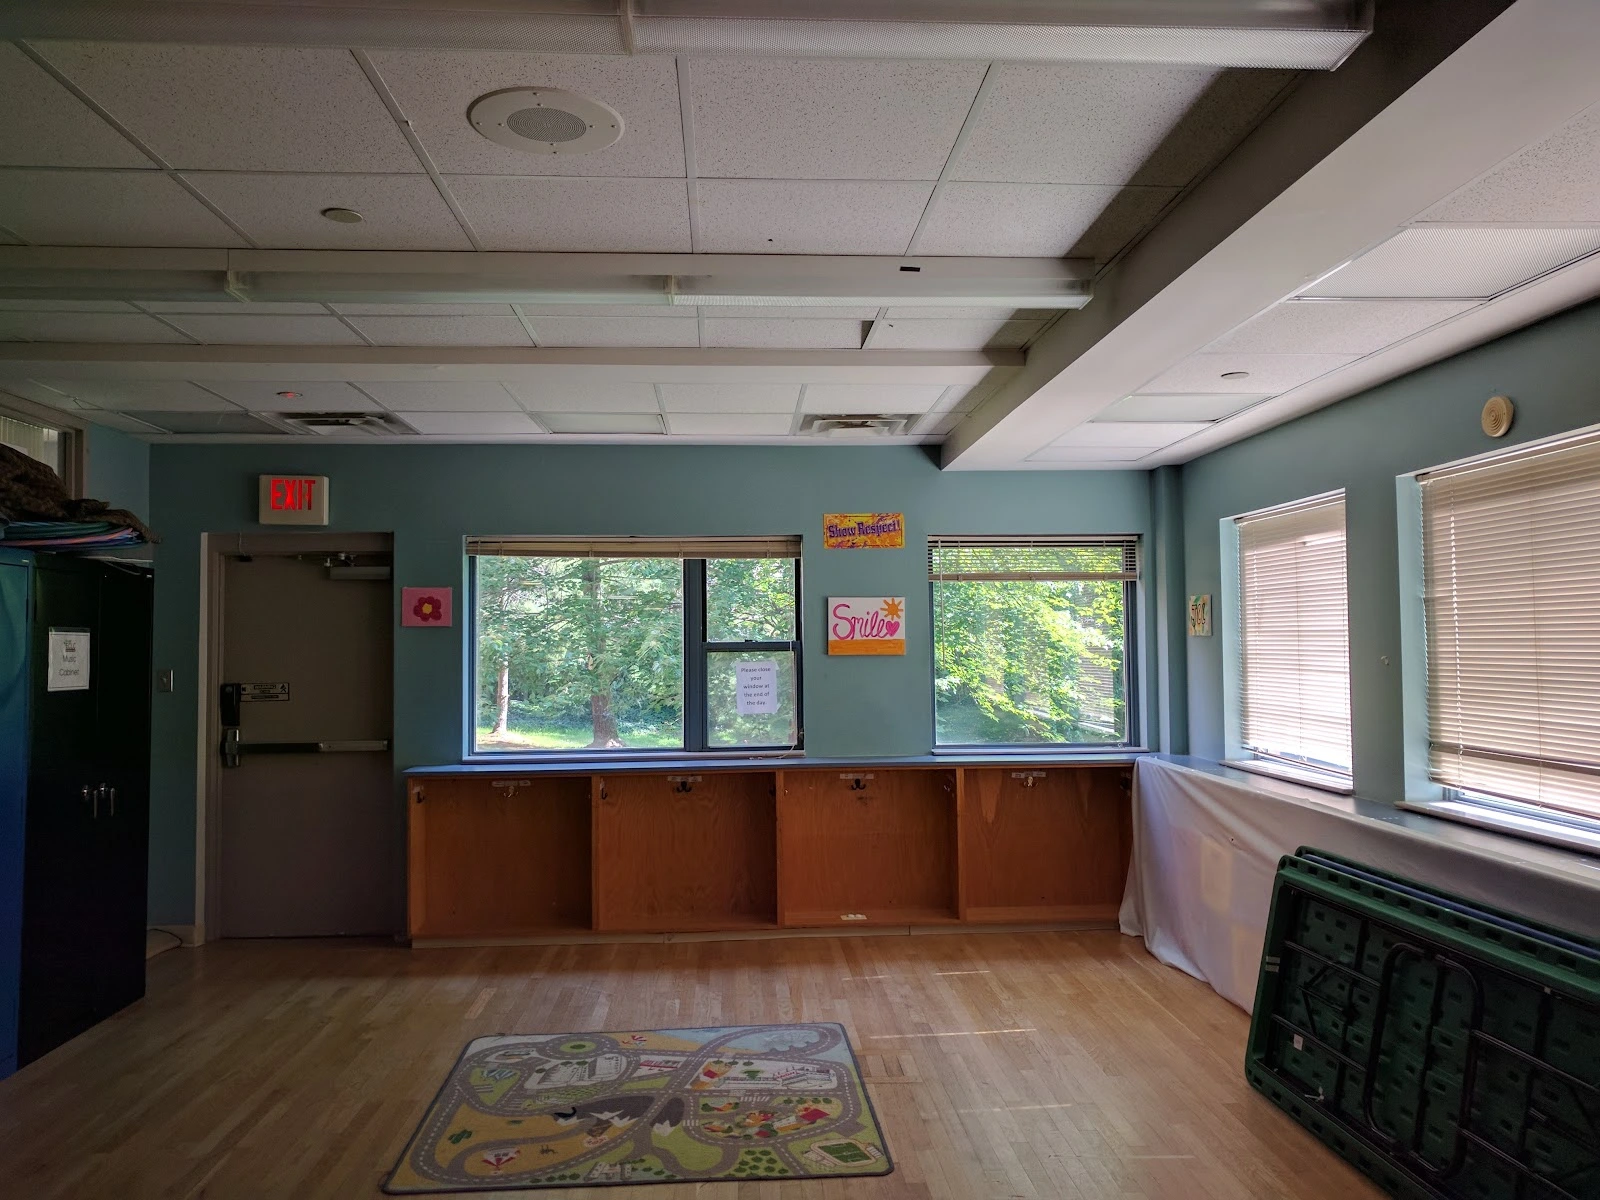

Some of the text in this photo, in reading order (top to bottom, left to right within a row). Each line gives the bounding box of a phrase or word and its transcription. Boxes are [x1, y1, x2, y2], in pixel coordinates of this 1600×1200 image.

[270, 479, 317, 511] EXIT
[828, 519, 901, 538] Show Respect!
[832, 603, 888, 640] Smile
[62, 655, 77, 663] Music
[59, 669, 80, 677] Cabinet
